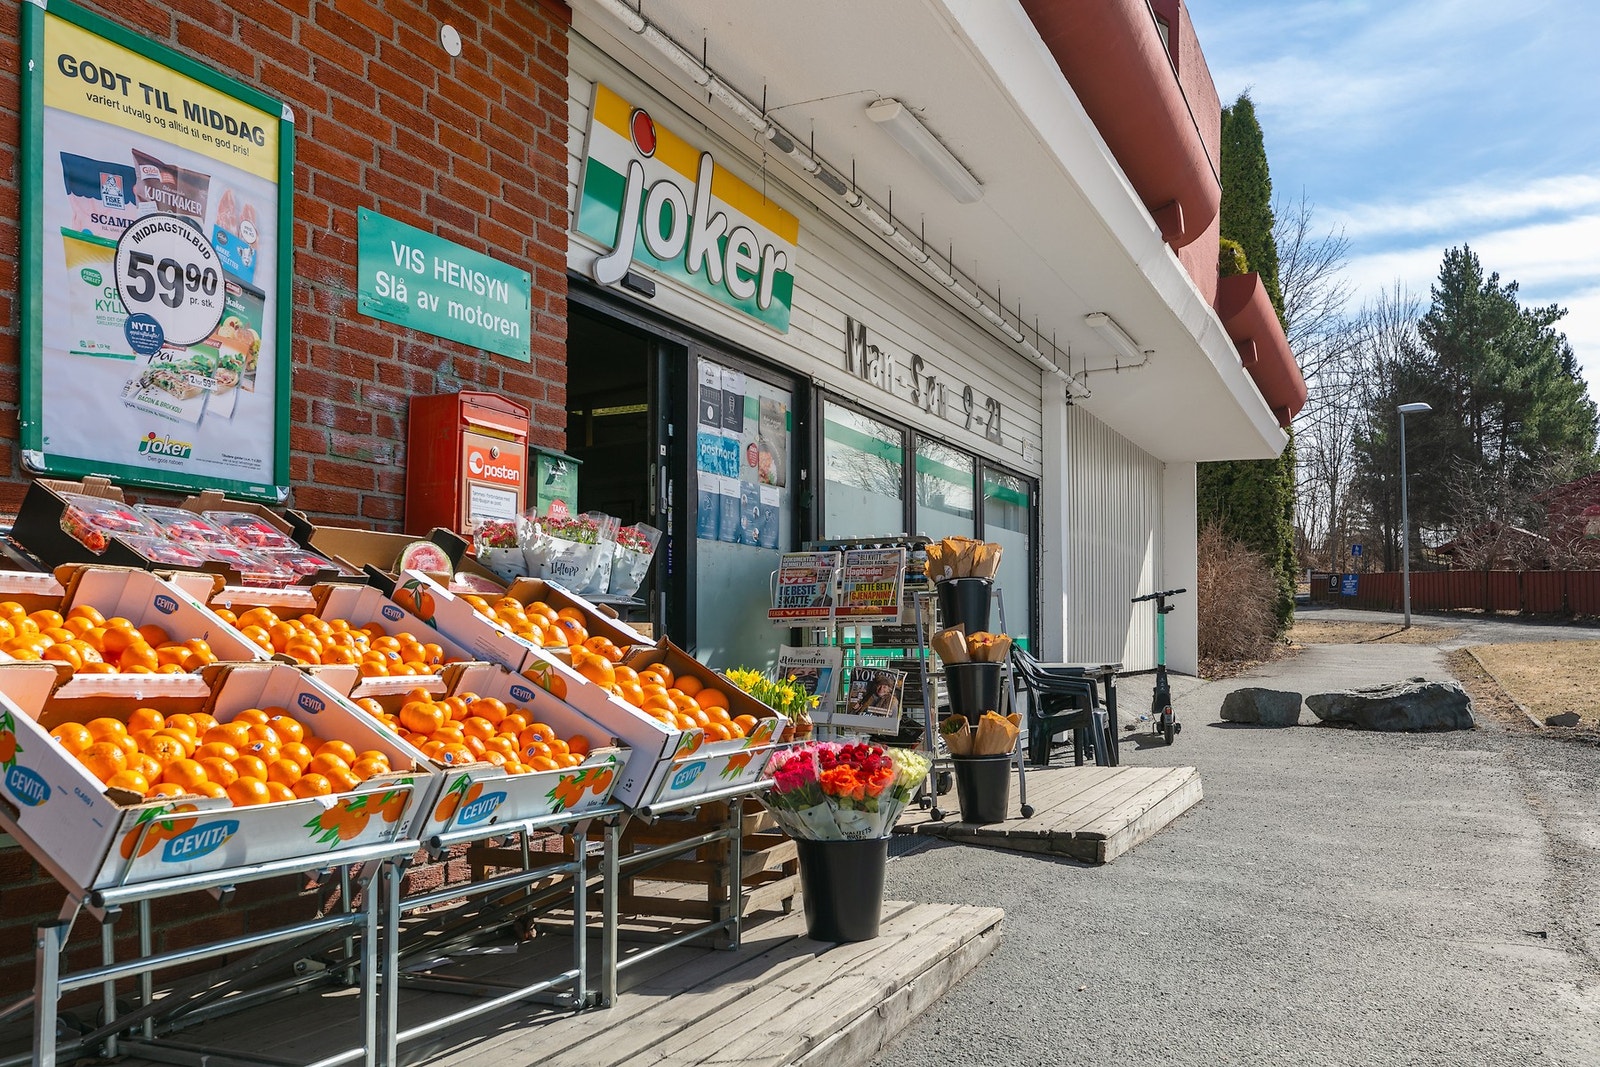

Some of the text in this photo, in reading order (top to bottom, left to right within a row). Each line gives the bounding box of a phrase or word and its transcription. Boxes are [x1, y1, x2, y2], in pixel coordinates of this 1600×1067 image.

[57, 54, 265, 147] GODT TIL MIDDAG
[86, 92, 250, 156] variert utvalg og alltid til en god pris!
[144, 185, 203, 215] KJØTTKAKER
[592, 108, 788, 311] joker
[132, 222, 211, 260] MIDDAGSTILBUD
[391, 240, 509, 304] VIS HENSYN
[190, 297, 214, 308] pr. stk.
[375, 270, 520, 339] Slå av motoren
[131, 321, 156, 332] NYTT
[190, 375, 195, 384] 2
[140, 432, 190, 456] joker
[484, 463, 520, 481] posten
[846, 567, 882, 576] Dagbladet
[791, 584, 816, 595] BESTE
[156, 597, 178, 612] CEVITA
[300, 696, 323, 712] CEVITA
[512, 687, 533, 702] CEVITA
[10, 769, 45, 800] CEVITA
[675, 765, 702, 786] CEVITA
[463, 793, 500, 819] CEVITA
[171, 825, 229, 856] CEVITA
